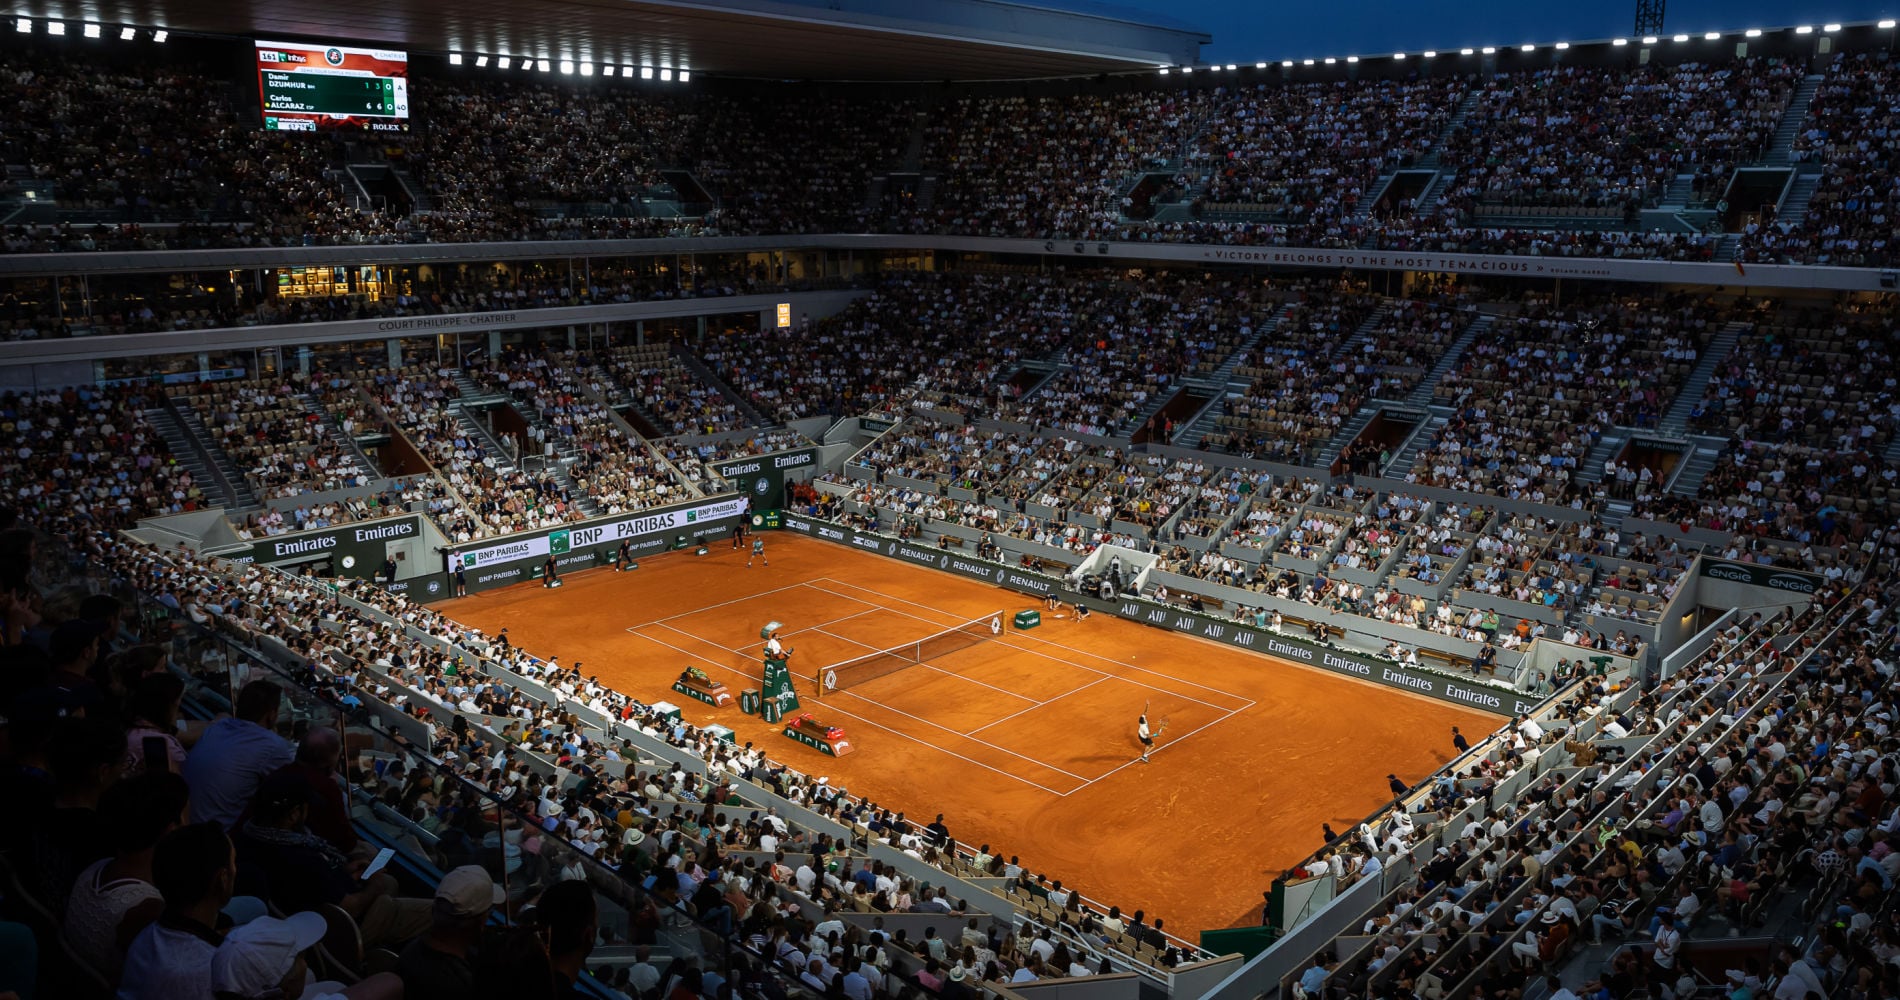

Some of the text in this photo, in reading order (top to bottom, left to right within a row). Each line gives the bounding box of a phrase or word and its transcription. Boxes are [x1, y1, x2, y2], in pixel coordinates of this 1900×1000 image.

[262, 52, 277, 61] 161
[268, 73, 289, 81] Damir
[268, 80, 306, 89] DZUMHUR
[270, 94, 293, 102] Carlos
[270, 102, 305, 110] ALCARAZ
[366, 102, 372, 110] 6
[372, 123, 400, 131] ROLEX
[1216, 250, 1268, 260] VICTORY
[1275, 254, 1332, 264] BELONGS
[1339, 255, 1354, 265] TO
[1362, 257, 1387, 266] THE
[1394, 258, 1432, 267] MOST
[1440, 260, 1528, 272] TENACIOUS
[379, 320, 415, 331] COURT
[417, 317, 461, 328] PHILIPPE
[470, 313, 516, 324] CHATRIER
[775, 453, 811, 468] Emirates
[722, 462, 761, 477] Emirates
[698, 507, 712, 517] BNP
[712, 502, 738, 514] PARIBAS
[355, 521, 413, 542] Emirates
[573, 528, 603, 546] BNP
[617, 513, 675, 537] PARIBAS
[693, 526, 727, 538] BNP PARIBAS
[796, 521, 811, 532] ISDIN
[828, 529, 845, 540] ISDIN
[274, 535, 337, 556] Emirates
[478, 550, 495, 560] BNP
[496, 543, 529, 556] PARIBAS
[640, 539, 664, 549] PARIBAS
[863, 539, 880, 550] ISDIN
[556, 553, 595, 567] BNP PARIBAS
[900, 547, 936, 563] RENAULT
[478, 568, 521, 583] BNP PARIBAS
[953, 560, 991, 577] RENAULT
[1009, 575, 1050, 592] RENAULT
[1268, 639, 1313, 660] Emirates
[1323, 653, 1371, 675] Emirates
[1382, 668, 1433, 691] Emirates
[1445, 684, 1501, 708] Emirates
